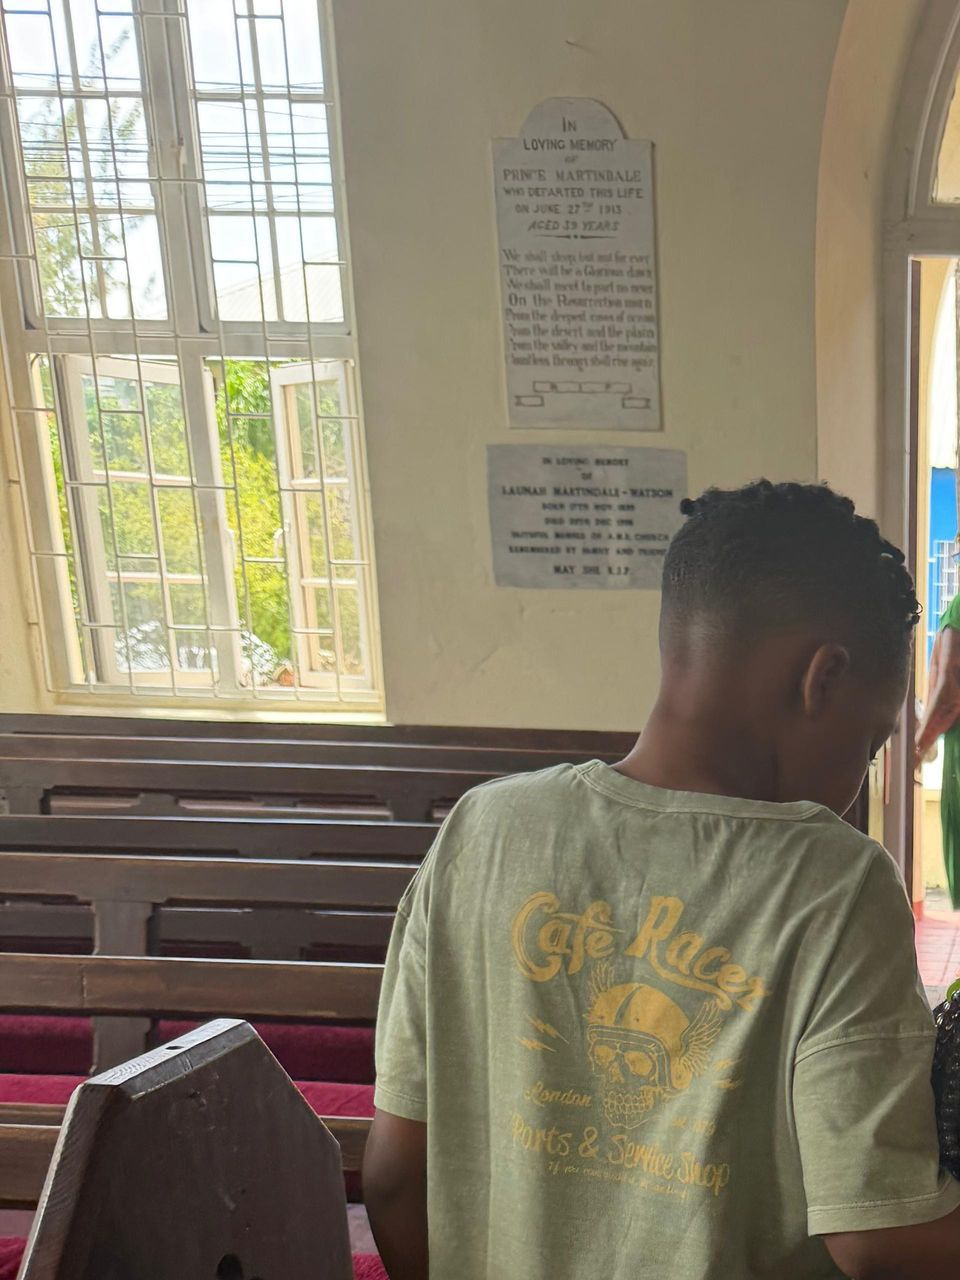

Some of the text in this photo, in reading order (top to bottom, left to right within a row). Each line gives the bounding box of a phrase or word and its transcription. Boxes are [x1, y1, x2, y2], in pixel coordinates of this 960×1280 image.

[562, 117, 577, 132] IN
[523, 138, 617, 151] LOVING MEMORY
[556, 170, 641, 182] MARTINDALE
[528, 187, 584, 198] DEPARTED
[590, 188, 613, 198] THIS
[617, 188, 644, 199] LIFE
[514, 204, 529, 214] ON
[533, 204, 560, 214] JUNE
[528, 220, 560, 231] AGED
[582, 220, 621, 231] YEARS
[508, 292, 527, 307] On
[556, 457, 590, 465] LOVING
[553, 566, 575, 575] MAY
[624, 895, 768, 1013] Racer
[523, 1081, 593, 1110] London
[512, 1110, 573, 1156] Parts
[578, 1126, 602, 1159] &
[607, 1133, 675, 1183] Service
[676, 1150, 731, 1197] Shop
